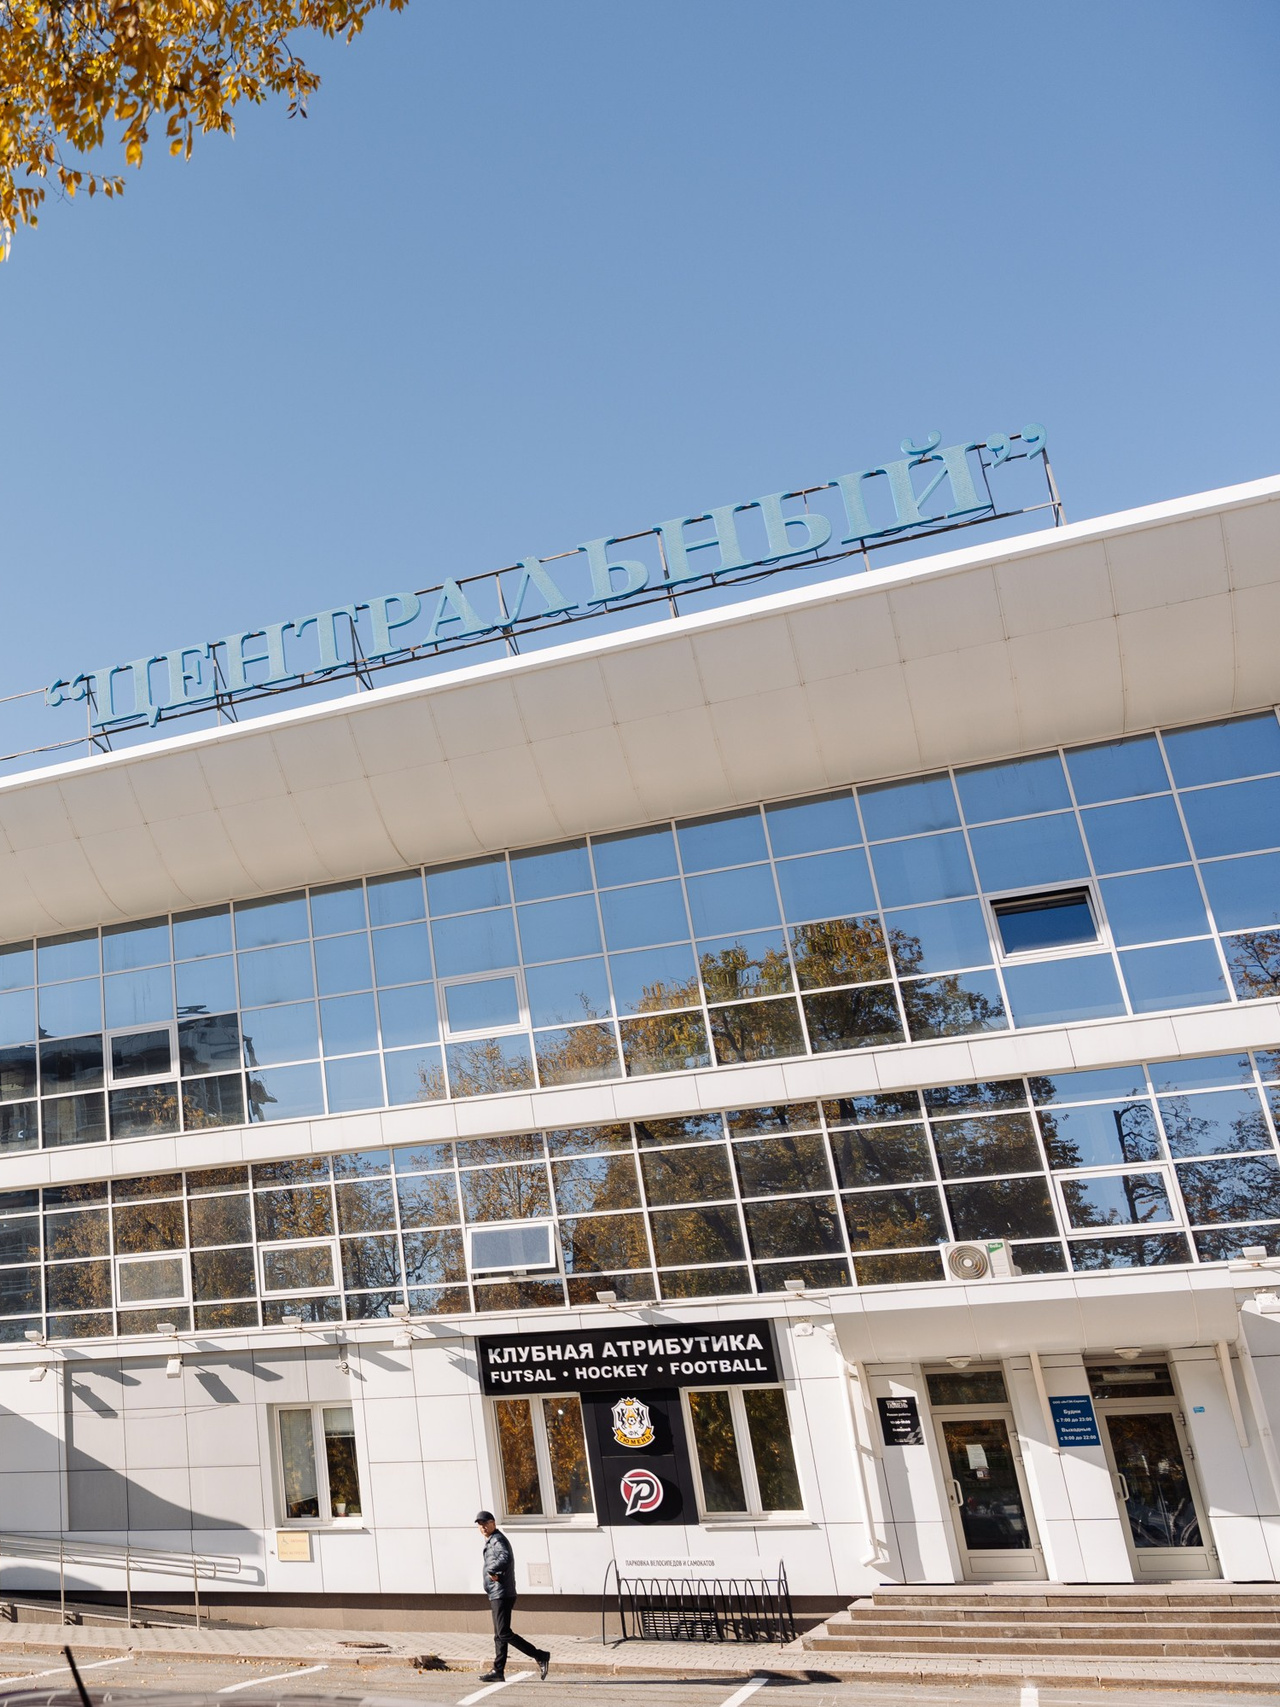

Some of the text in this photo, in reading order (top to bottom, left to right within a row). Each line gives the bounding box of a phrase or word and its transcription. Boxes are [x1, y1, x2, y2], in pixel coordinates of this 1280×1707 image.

[488, 1333, 764, 1364] КЛУБНАЯ АТРИБУТИКА
[490, 1358, 768, 1384] FUTSAL HOCKEY FOOTBALL
[619, 1434, 652, 1446] ТЮМЕНЬ
